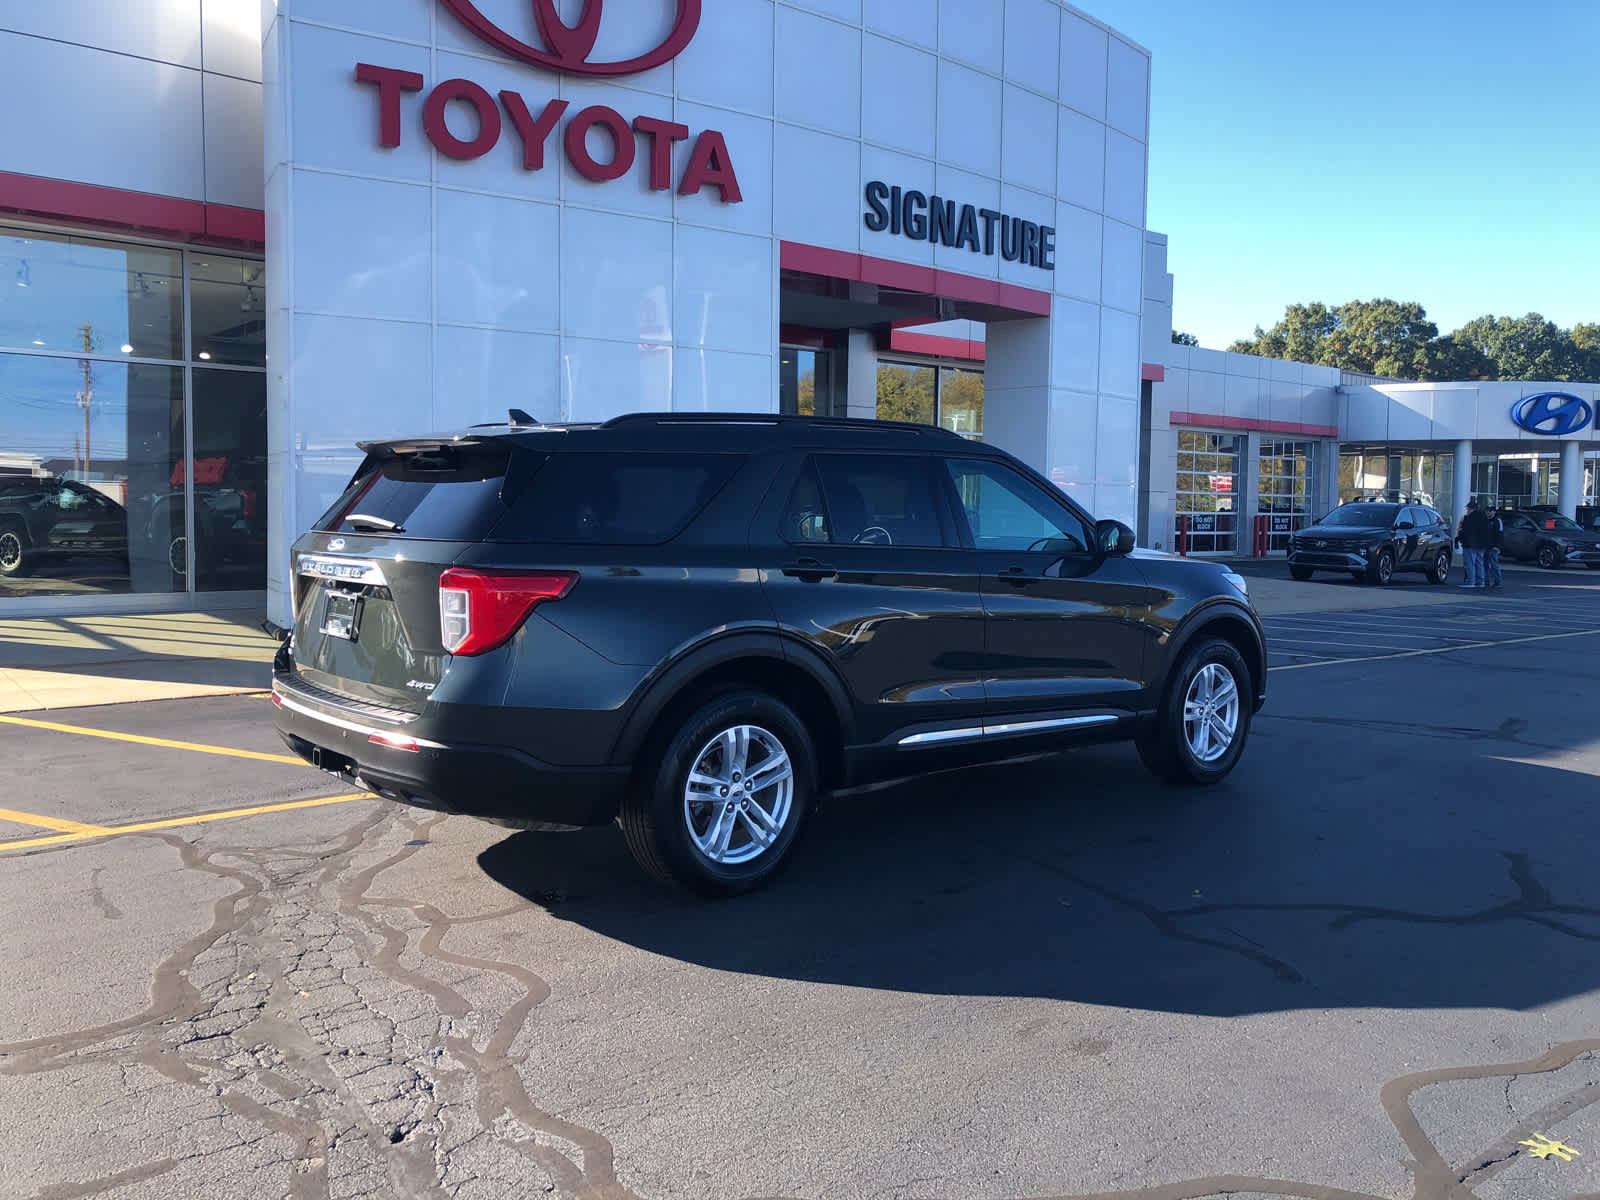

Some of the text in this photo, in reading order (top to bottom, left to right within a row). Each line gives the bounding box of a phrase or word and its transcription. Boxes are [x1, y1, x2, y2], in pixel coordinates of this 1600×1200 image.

[354, 63, 743, 203] TOYOTA
[864, 181, 1055, 270] SIGNATURE
[406, 679, 436, 690] 4WD
